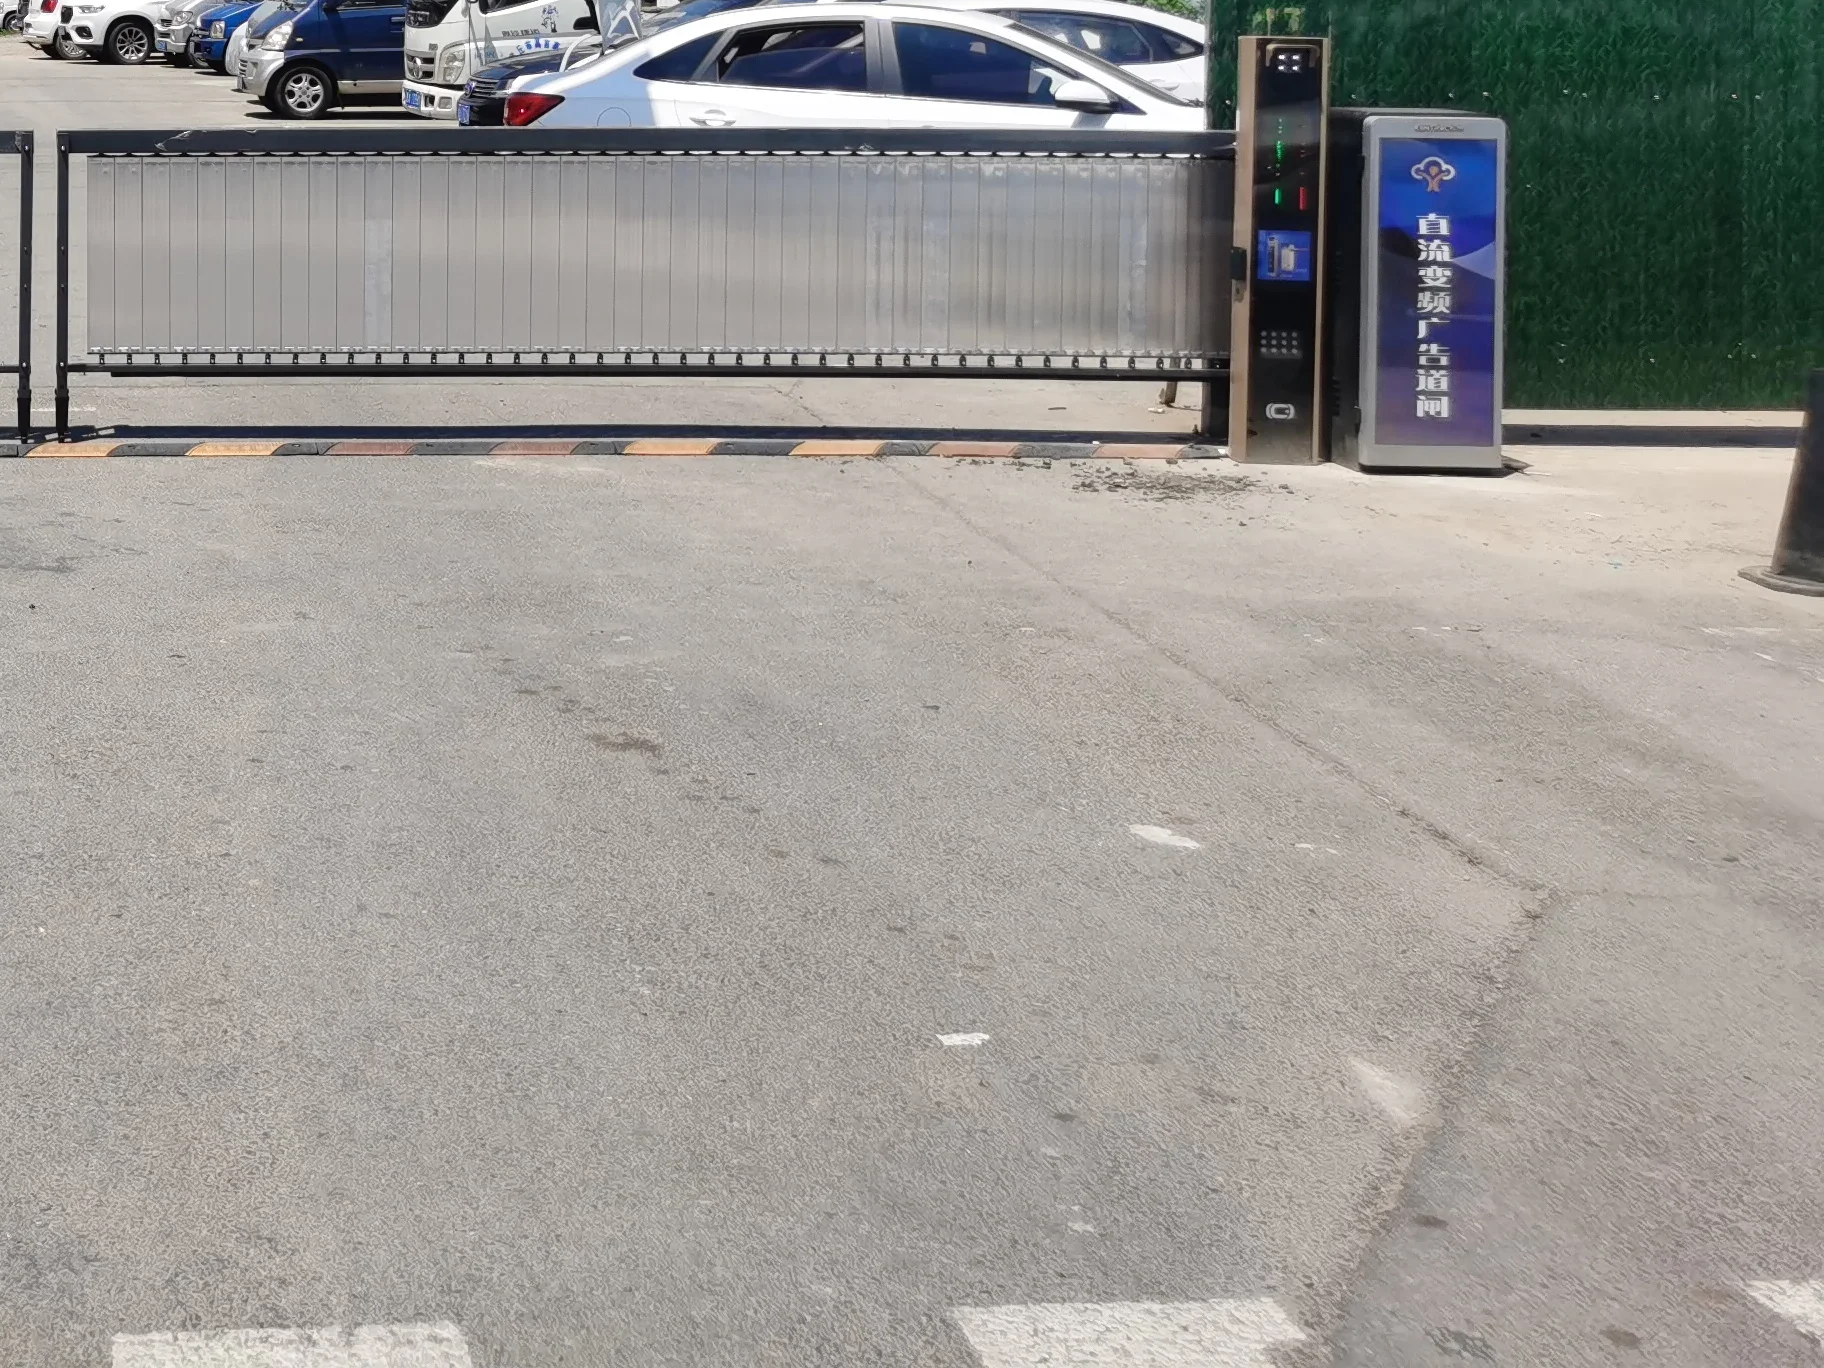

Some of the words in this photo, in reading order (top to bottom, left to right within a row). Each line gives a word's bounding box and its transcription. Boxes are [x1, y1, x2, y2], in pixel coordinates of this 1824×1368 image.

[1415, 212, 1452, 419] 直流变频广告道闸
